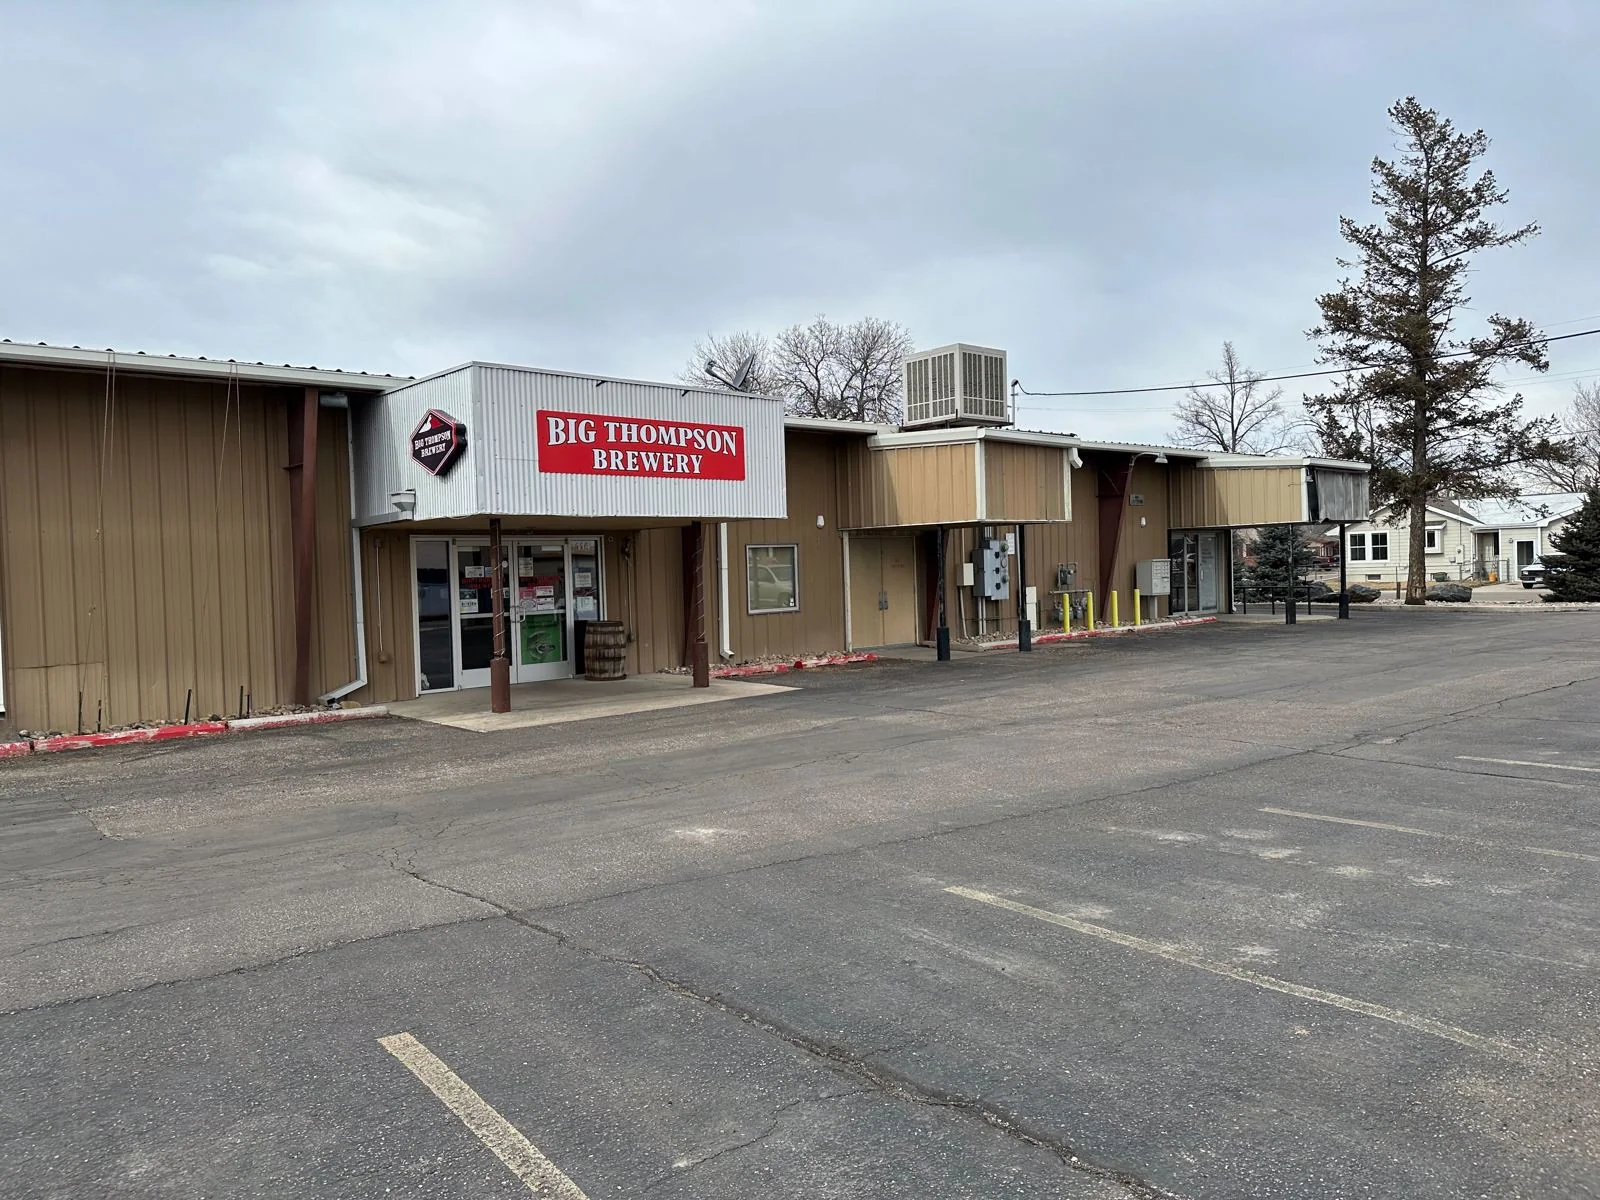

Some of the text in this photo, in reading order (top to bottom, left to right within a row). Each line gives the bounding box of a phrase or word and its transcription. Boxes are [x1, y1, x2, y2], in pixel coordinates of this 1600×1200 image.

[425, 430, 451, 446] THOMPSON
[547, 416, 737, 457] BIG THOMPSON
[420, 442, 446, 458] BREWERY
[592, 448, 703, 474] BREWERY
